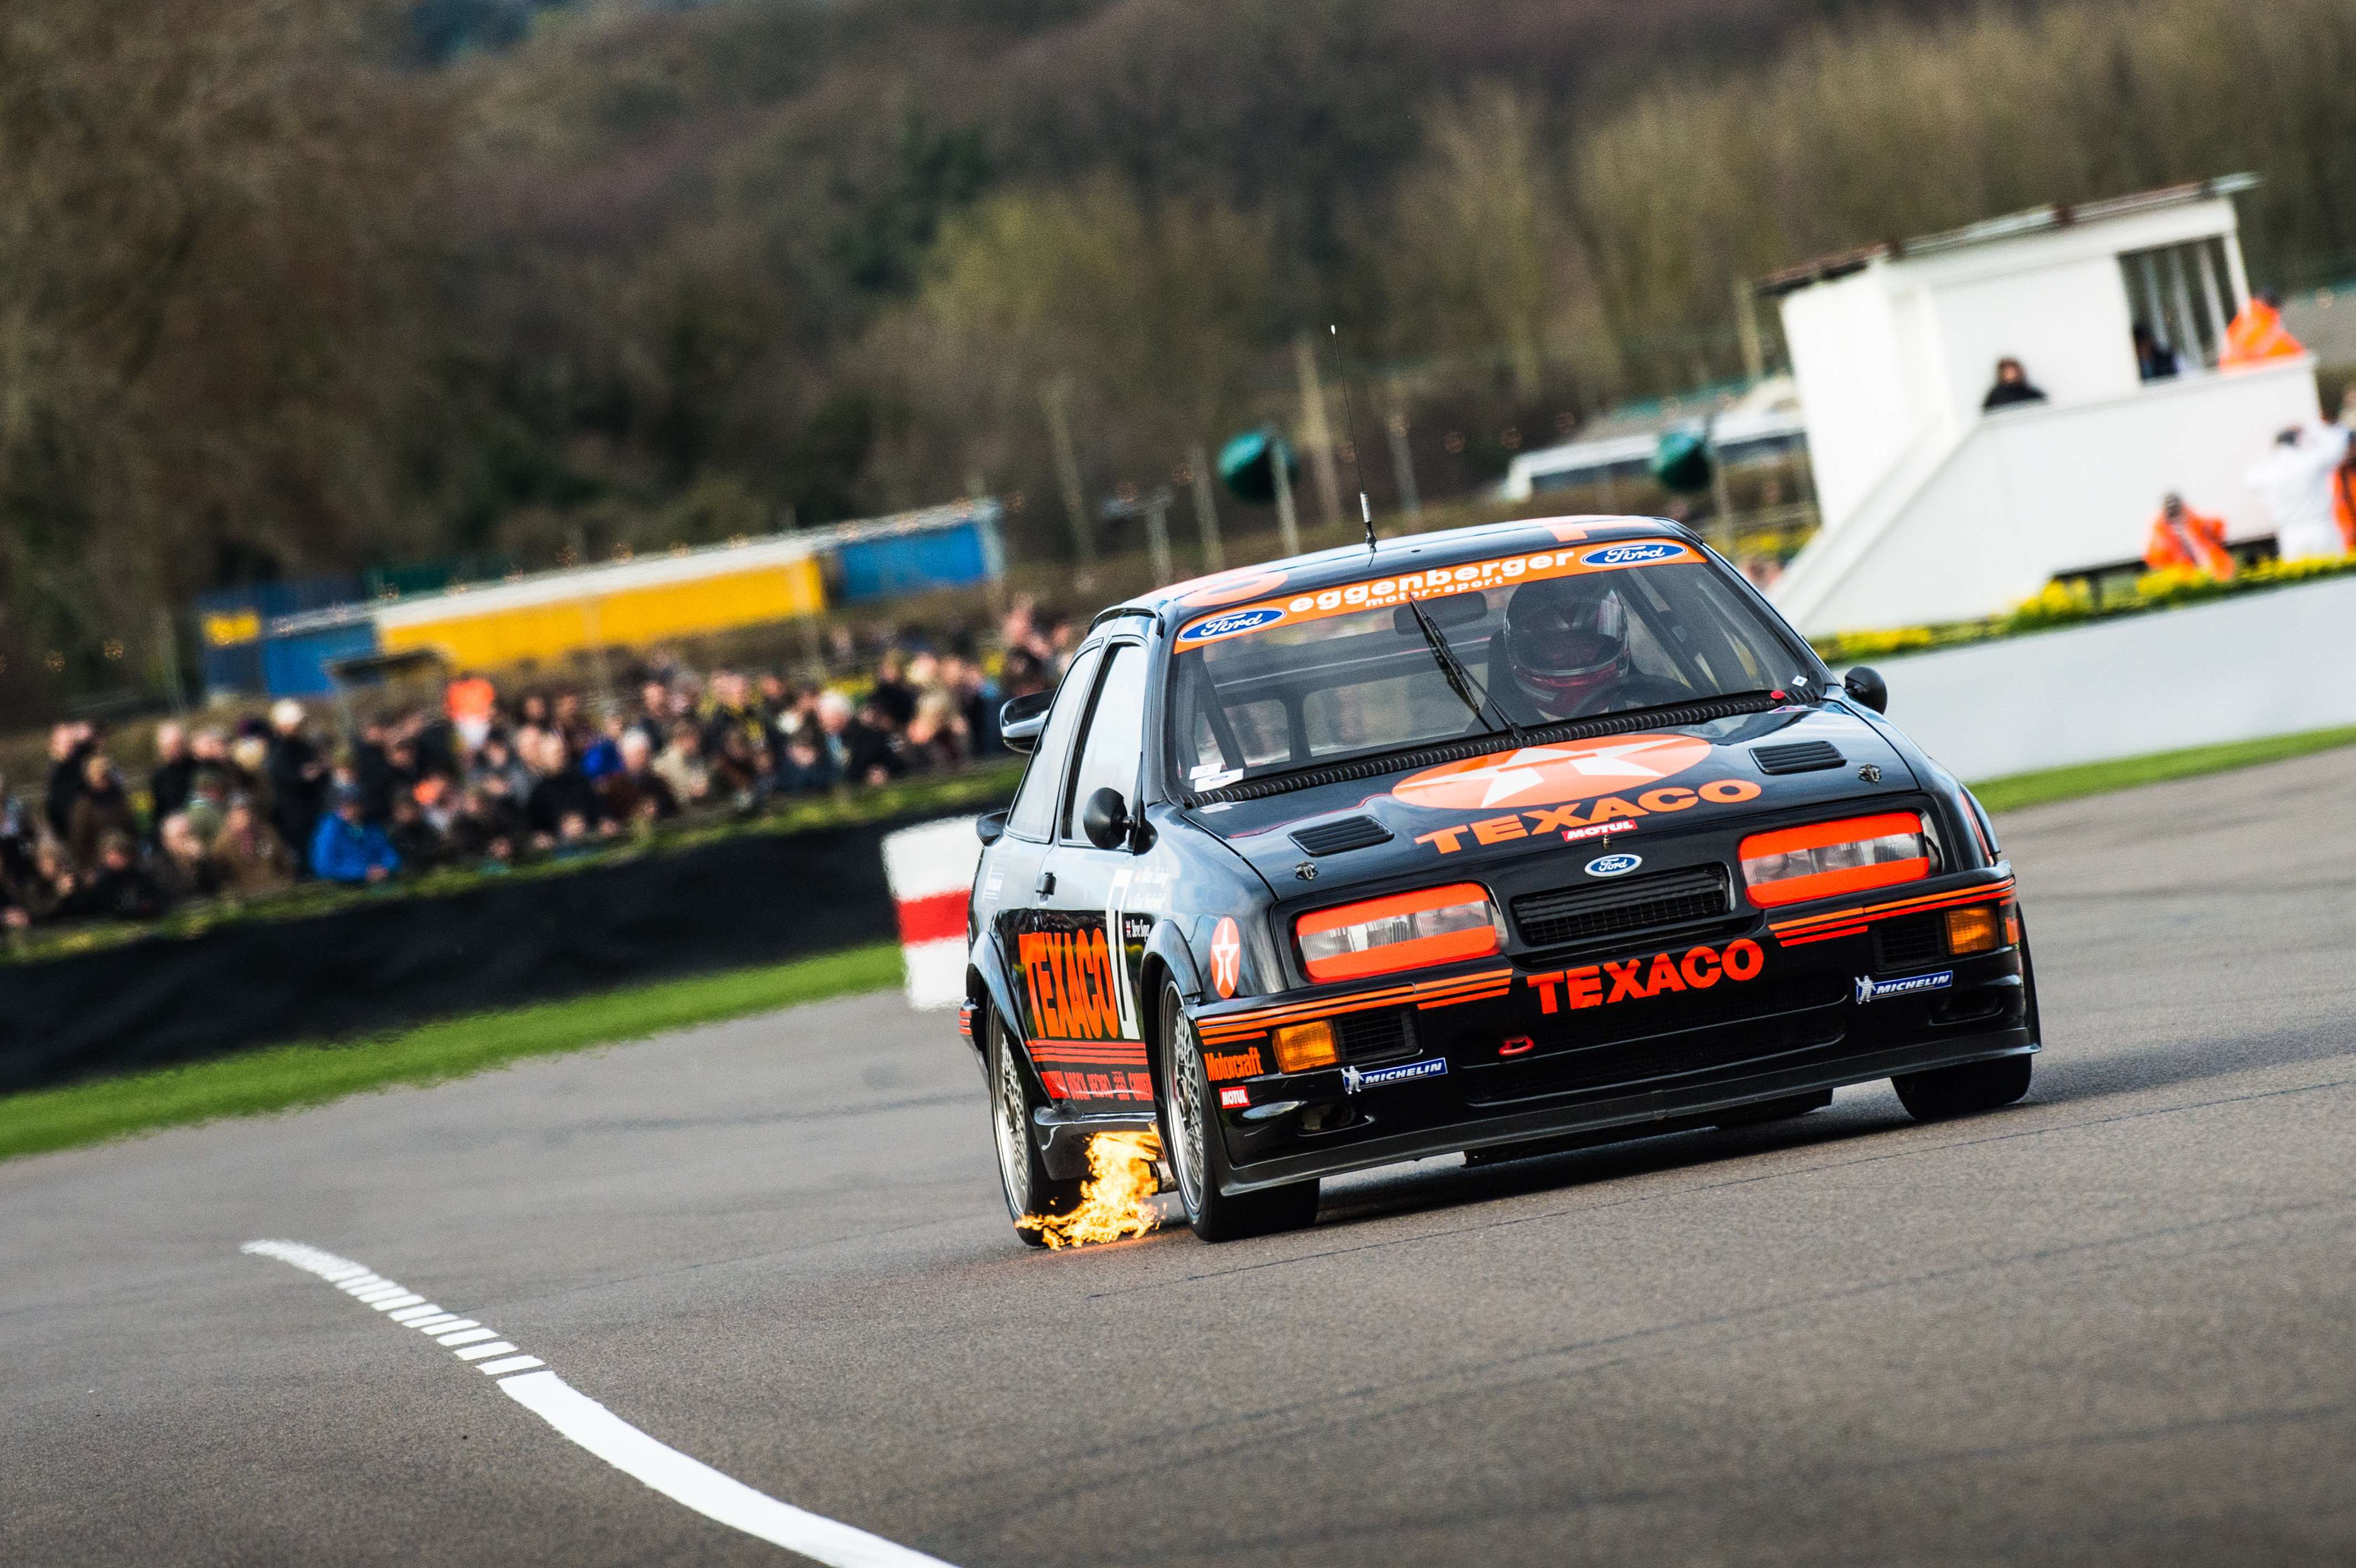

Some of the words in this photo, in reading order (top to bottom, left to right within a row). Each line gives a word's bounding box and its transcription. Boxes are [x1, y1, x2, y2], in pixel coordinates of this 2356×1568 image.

[1604, 545, 1666, 563] Ford
[1288, 551, 1575, 613] eggenberger
[1365, 575, 1503, 608] motor-sport
[1200, 613, 1263, 637] Ford
[1415, 779, 1762, 854] TEXACO
[1567, 821, 1633, 840] MOTUL
[1598, 858, 1628, 872] Ford
[1019, 928, 1118, 1039] TEXACO
[1527, 939, 1764, 1015] TEXACO
[1876, 974, 1950, 995] MICHELIN
[1203, 1047, 1264, 1081] Motorcraft
[1365, 1062, 1442, 1084] MICHELIN
[1222, 1089, 1248, 1106] MOTUL
